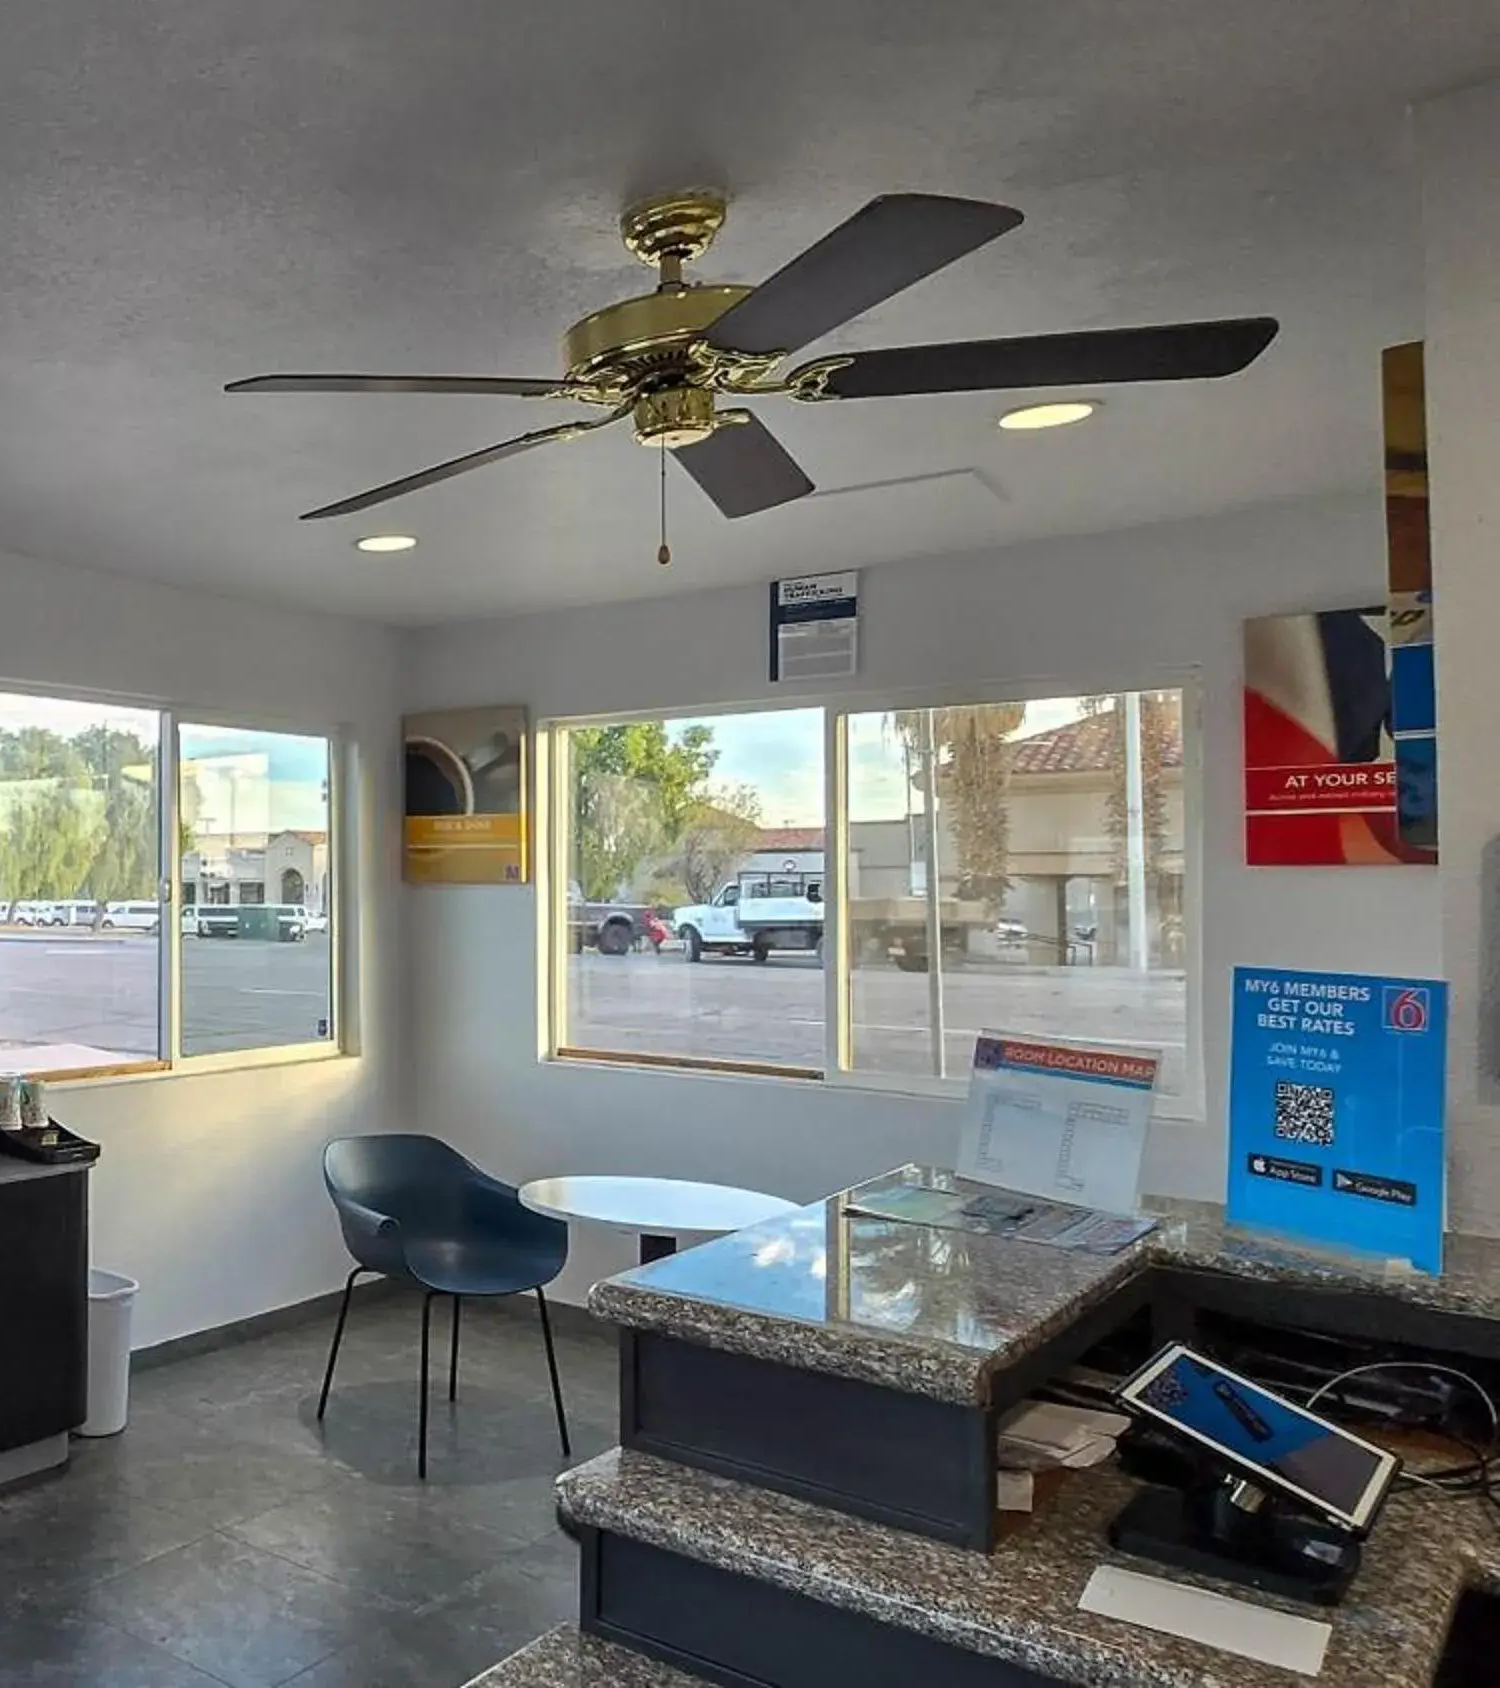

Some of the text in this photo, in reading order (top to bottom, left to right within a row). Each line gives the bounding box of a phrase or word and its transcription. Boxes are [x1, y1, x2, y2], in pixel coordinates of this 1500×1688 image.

[1284, 775, 1309, 789] AT
[1314, 773, 1368, 787] YOUR
[1245, 979, 1371, 1002] MY6 MEMBERS
[1267, 998, 1344, 1018] GET OUR
[1257, 1013, 1355, 1037] BEST RATES
[1269, 1042, 1297, 1054] JOIN
[1047, 1051, 1119, 1073] LOCATION
[1267, 1055, 1342, 1074] SAVE TODAY
[1355, 1182, 1390, 1198] Google
